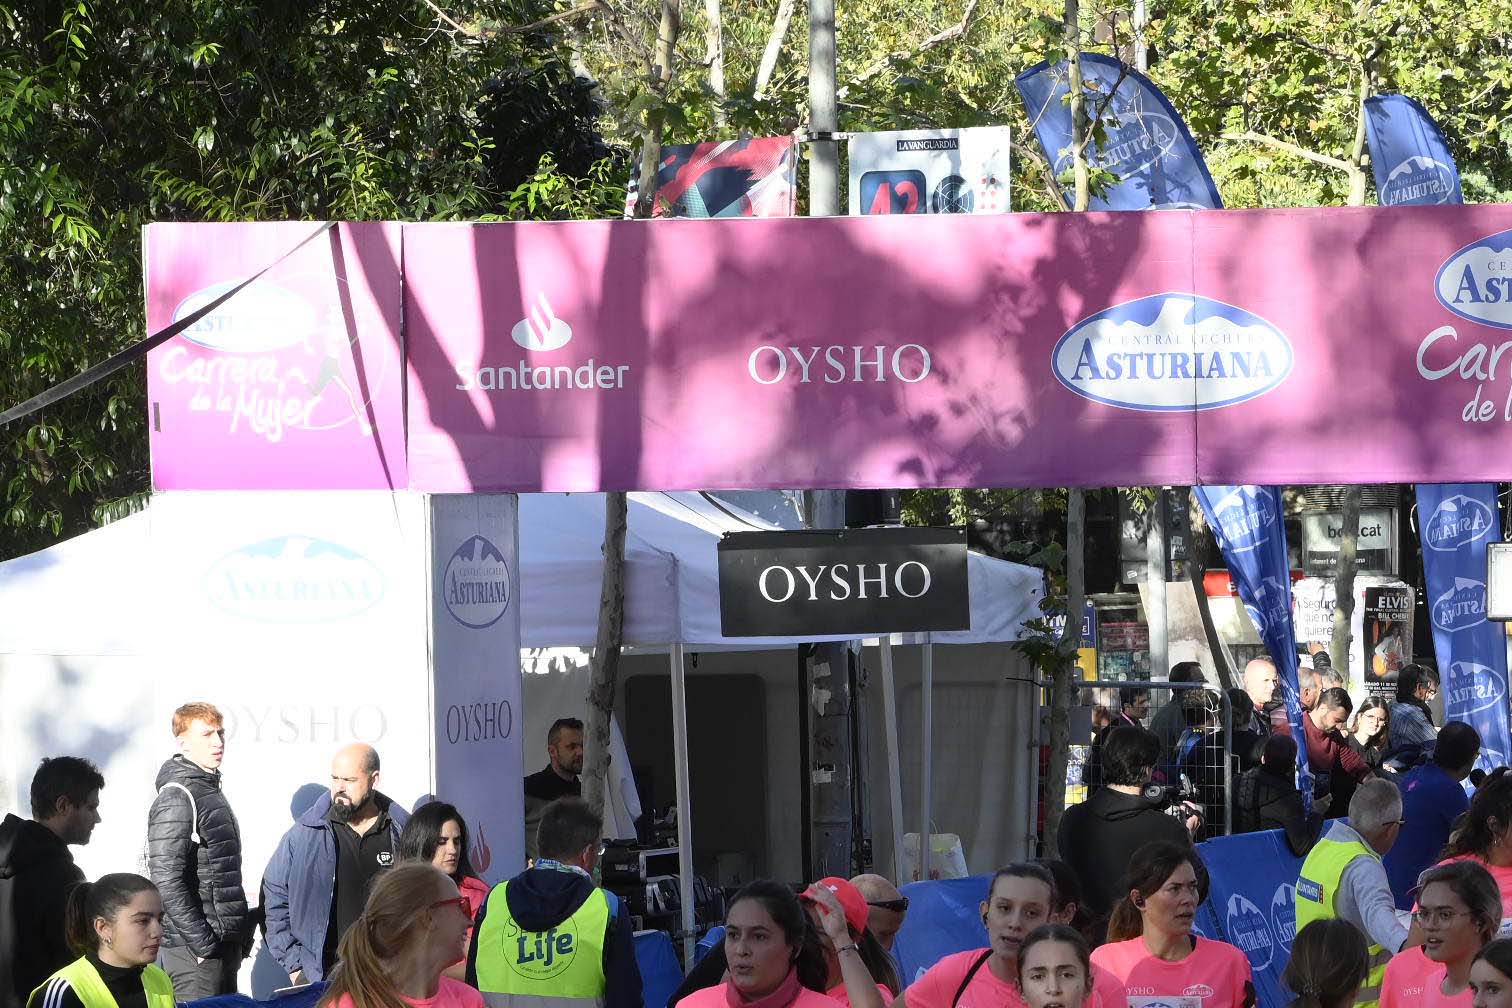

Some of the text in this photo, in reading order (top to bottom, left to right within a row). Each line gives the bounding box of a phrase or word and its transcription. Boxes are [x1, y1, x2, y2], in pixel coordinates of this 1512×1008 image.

[456, 359, 629, 390] Santander
[747, 343, 932, 385] OYSHO
[1071, 337, 1274, 380] ASTURIANA
[1462, 384, 1496, 422] de
[450, 570, 506, 605] ASTURIANA
[758, 560, 932, 603] OYSHO
[1378, 597, 1409, 609] ELVIS
[446, 700, 512, 745] OYSHO
[516, 928, 574, 967] Life
